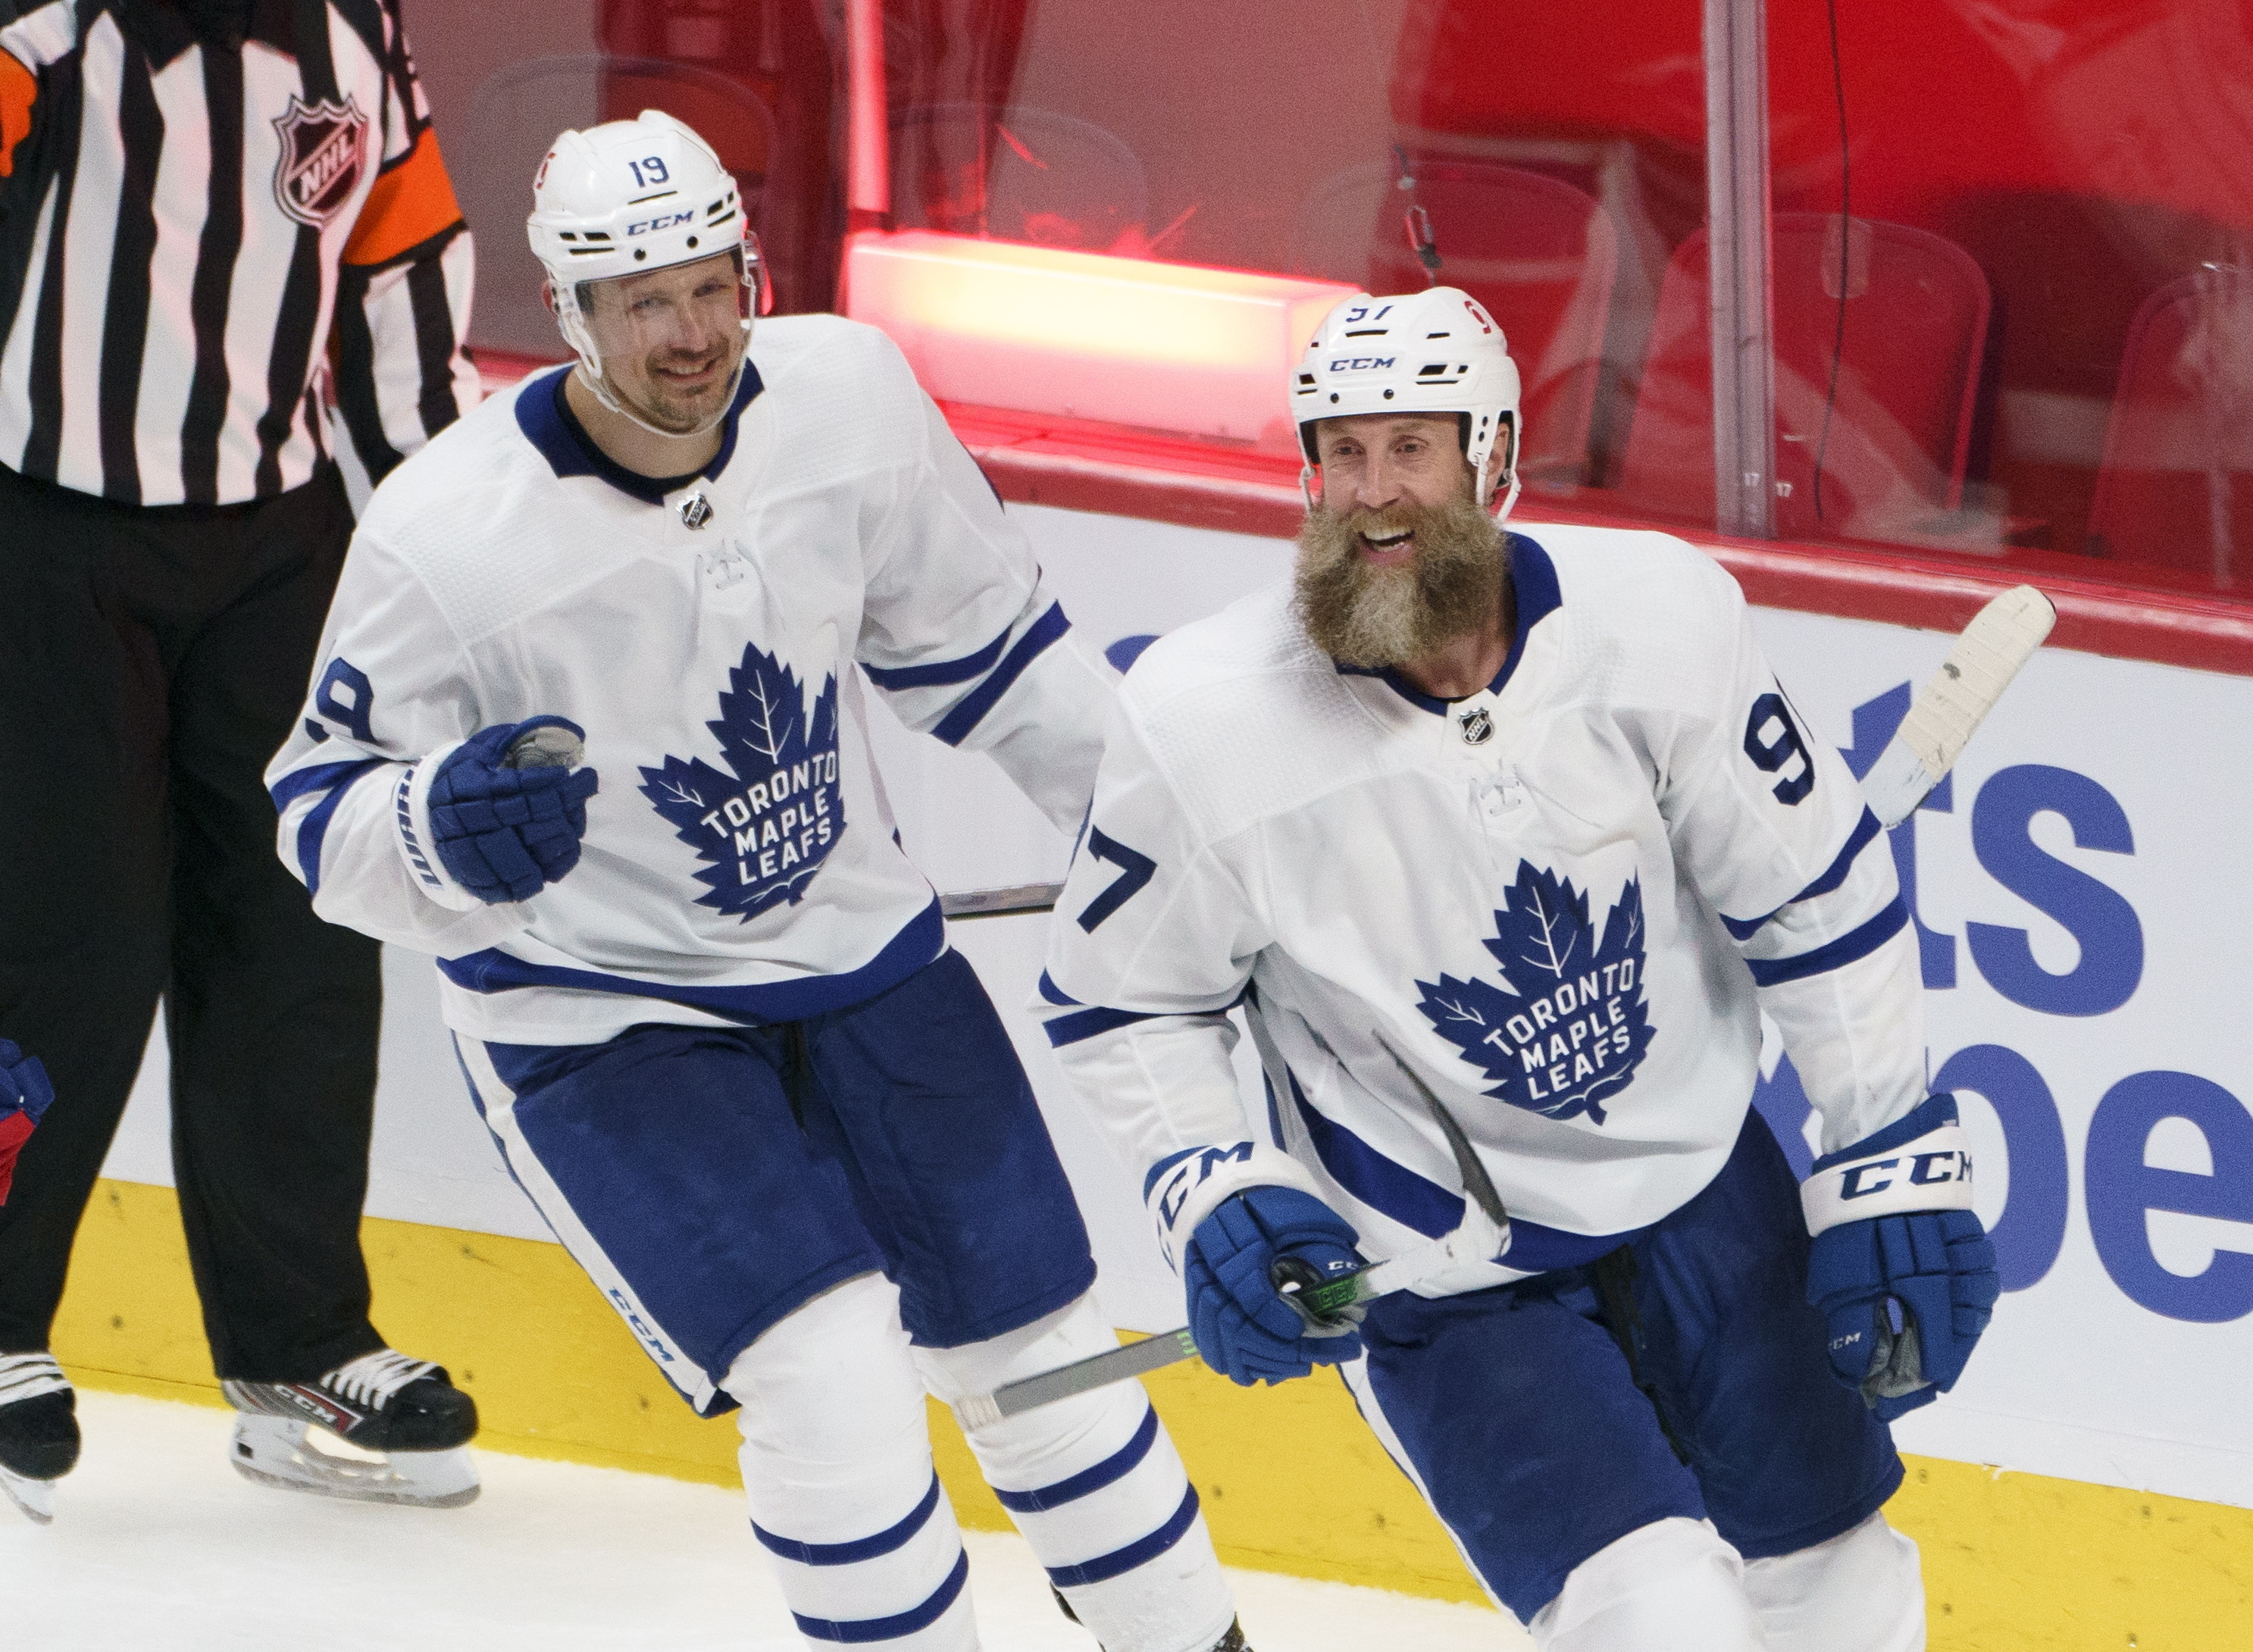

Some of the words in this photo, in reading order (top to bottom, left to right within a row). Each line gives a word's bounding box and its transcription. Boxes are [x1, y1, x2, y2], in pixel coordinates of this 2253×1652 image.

[301, 133, 353, 202] NHL
[628, 156, 670, 188] 19
[627, 210, 694, 236] CCM
[1330, 357, 1396, 372] CCM
[1468, 717, 1486, 741] NHL
[1744, 682, 1815, 806] 9
[701, 750, 837, 839] TORONTO
[734, 787, 830, 857] MAPLE
[739, 817, 832, 886] LEAFS
[1076, 811, 1158, 935] 7
[1482, 958, 1635, 1057] TORONTO
[1520, 996, 1626, 1074] MAPLE
[1527, 1025, 1631, 1100] LEAFS
[1840, 1150, 1973, 1201] CCM
[609, 1286, 676, 1363] CCM
[274, 1384, 338, 1424] CCM
